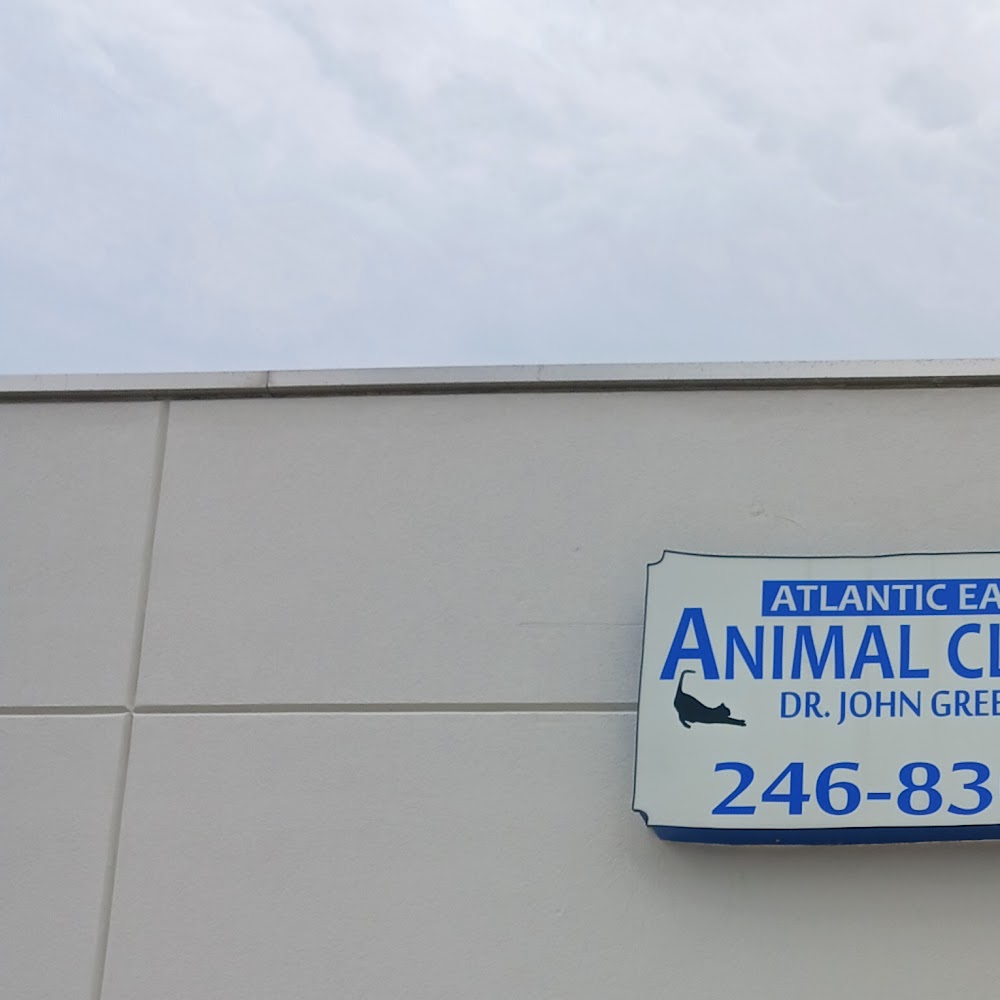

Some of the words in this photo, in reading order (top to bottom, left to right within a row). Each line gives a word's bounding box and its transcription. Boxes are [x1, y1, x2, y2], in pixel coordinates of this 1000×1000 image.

[770, 583, 947, 612] ATLANTIC
[659, 607, 930, 680] ANIMAL
[780, 692, 831, 719] DR.
[837, 691, 922, 726] JOHN
